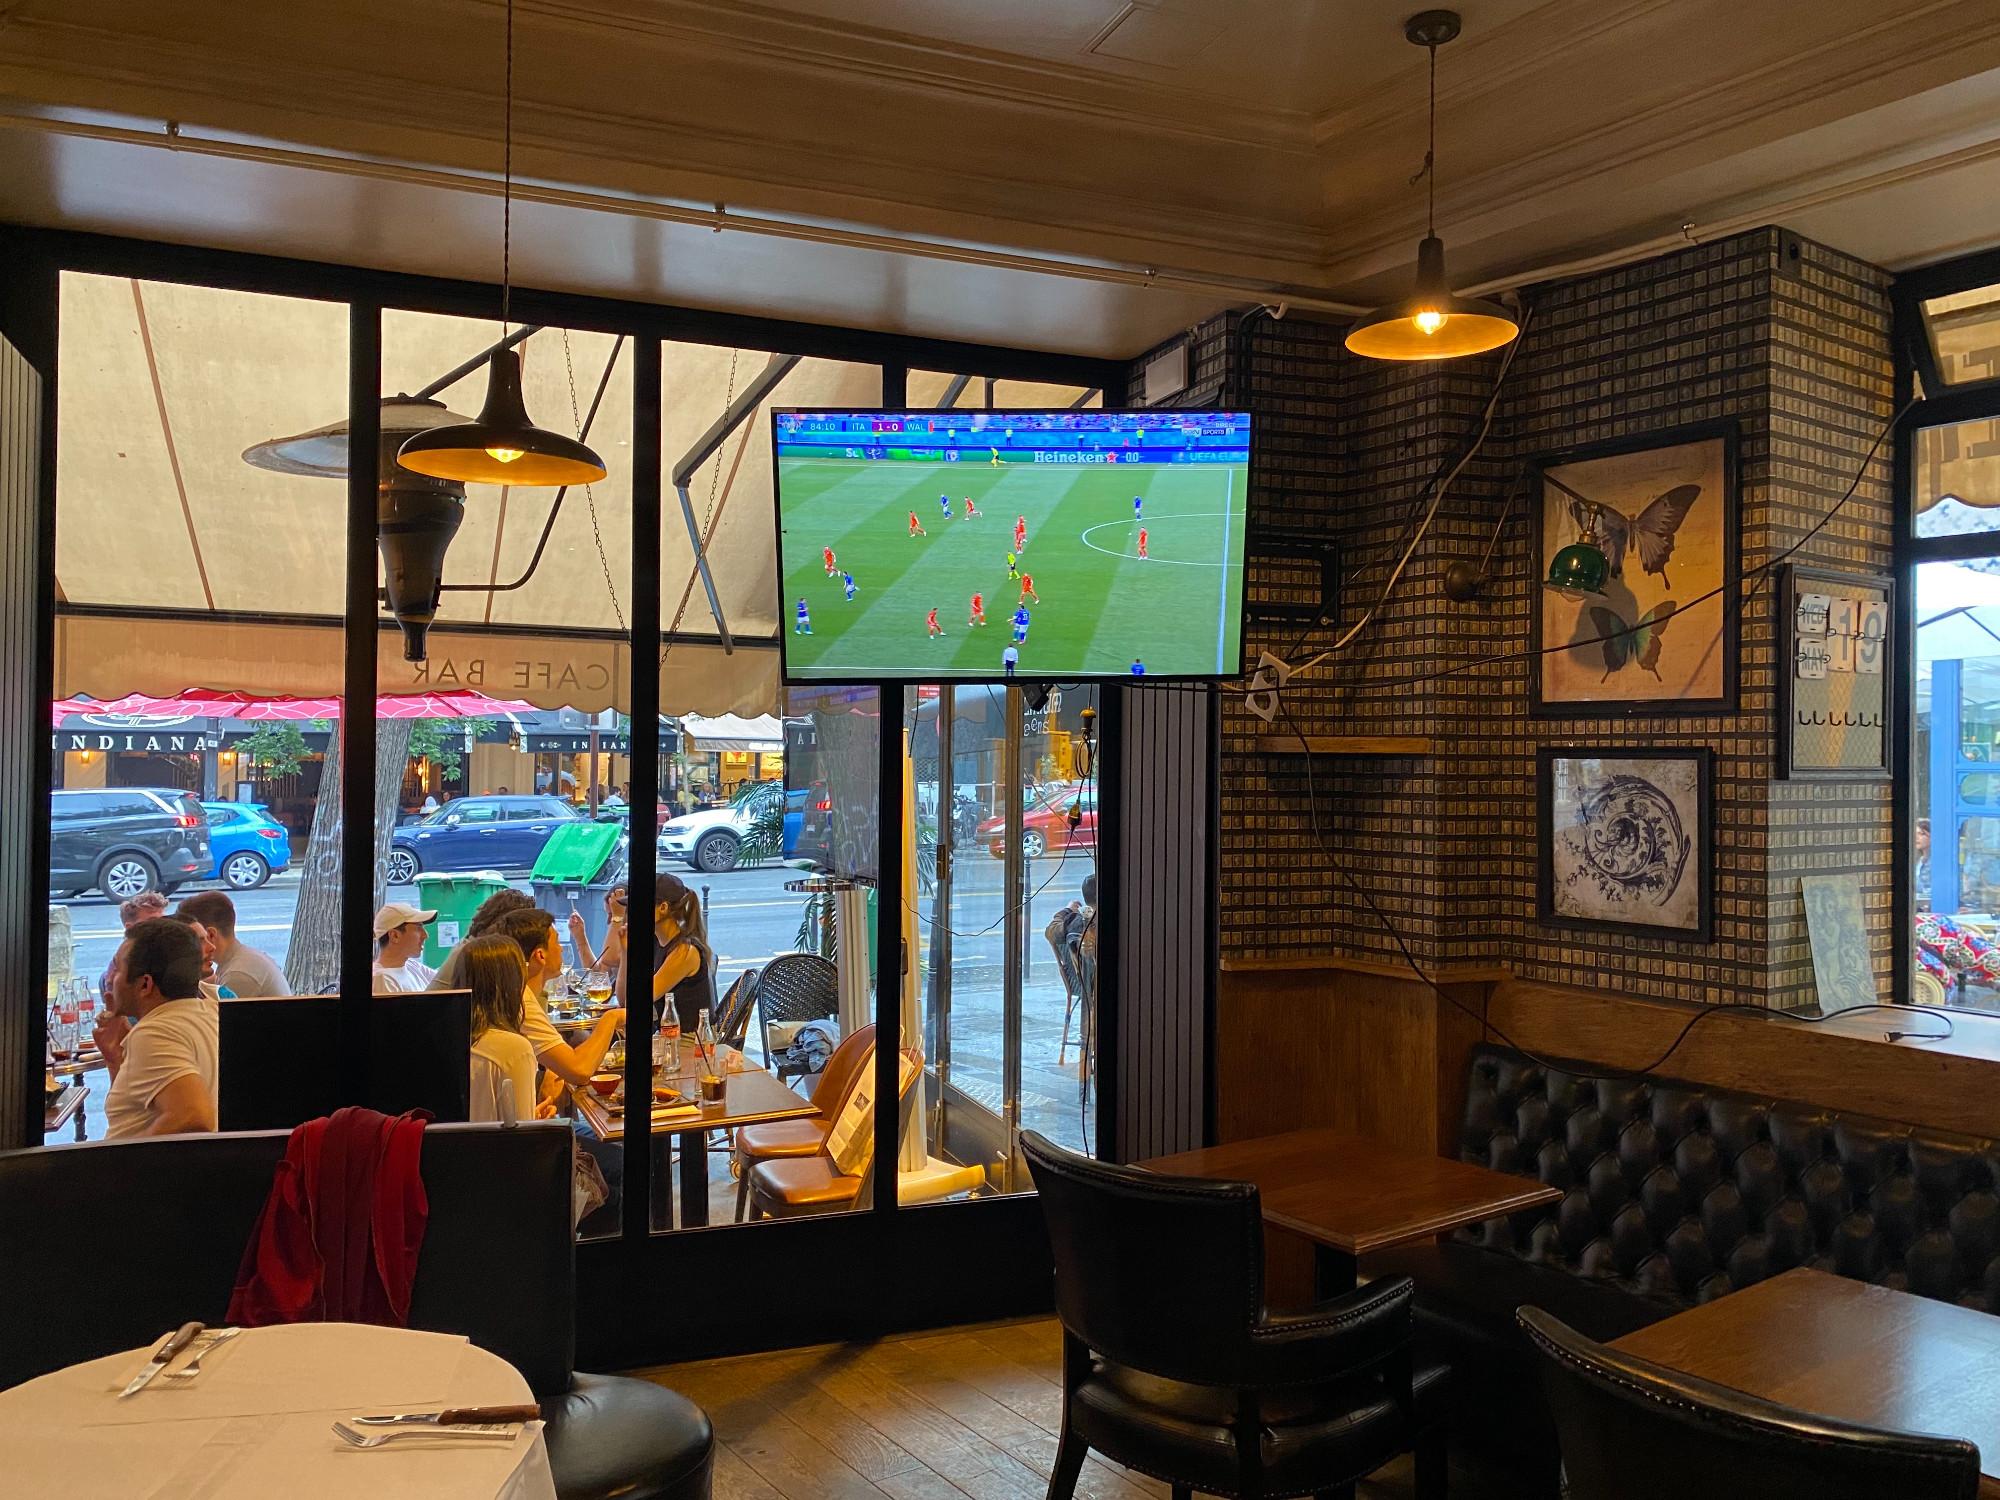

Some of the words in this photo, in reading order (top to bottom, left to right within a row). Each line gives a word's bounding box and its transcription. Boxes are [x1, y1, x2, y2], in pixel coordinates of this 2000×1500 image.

[810, 422, 836, 431] 84:10
[852, 422, 866, 431] ITA
[907, 422, 926, 431] WAL
[1034, 451, 1105, 463] Heineken
[1802, 602, 1825, 625] WED
[1801, 646, 1825, 672] MAY
[52, 734, 207, 751] INDIANA
[572, 741, 627, 750] INIAN
